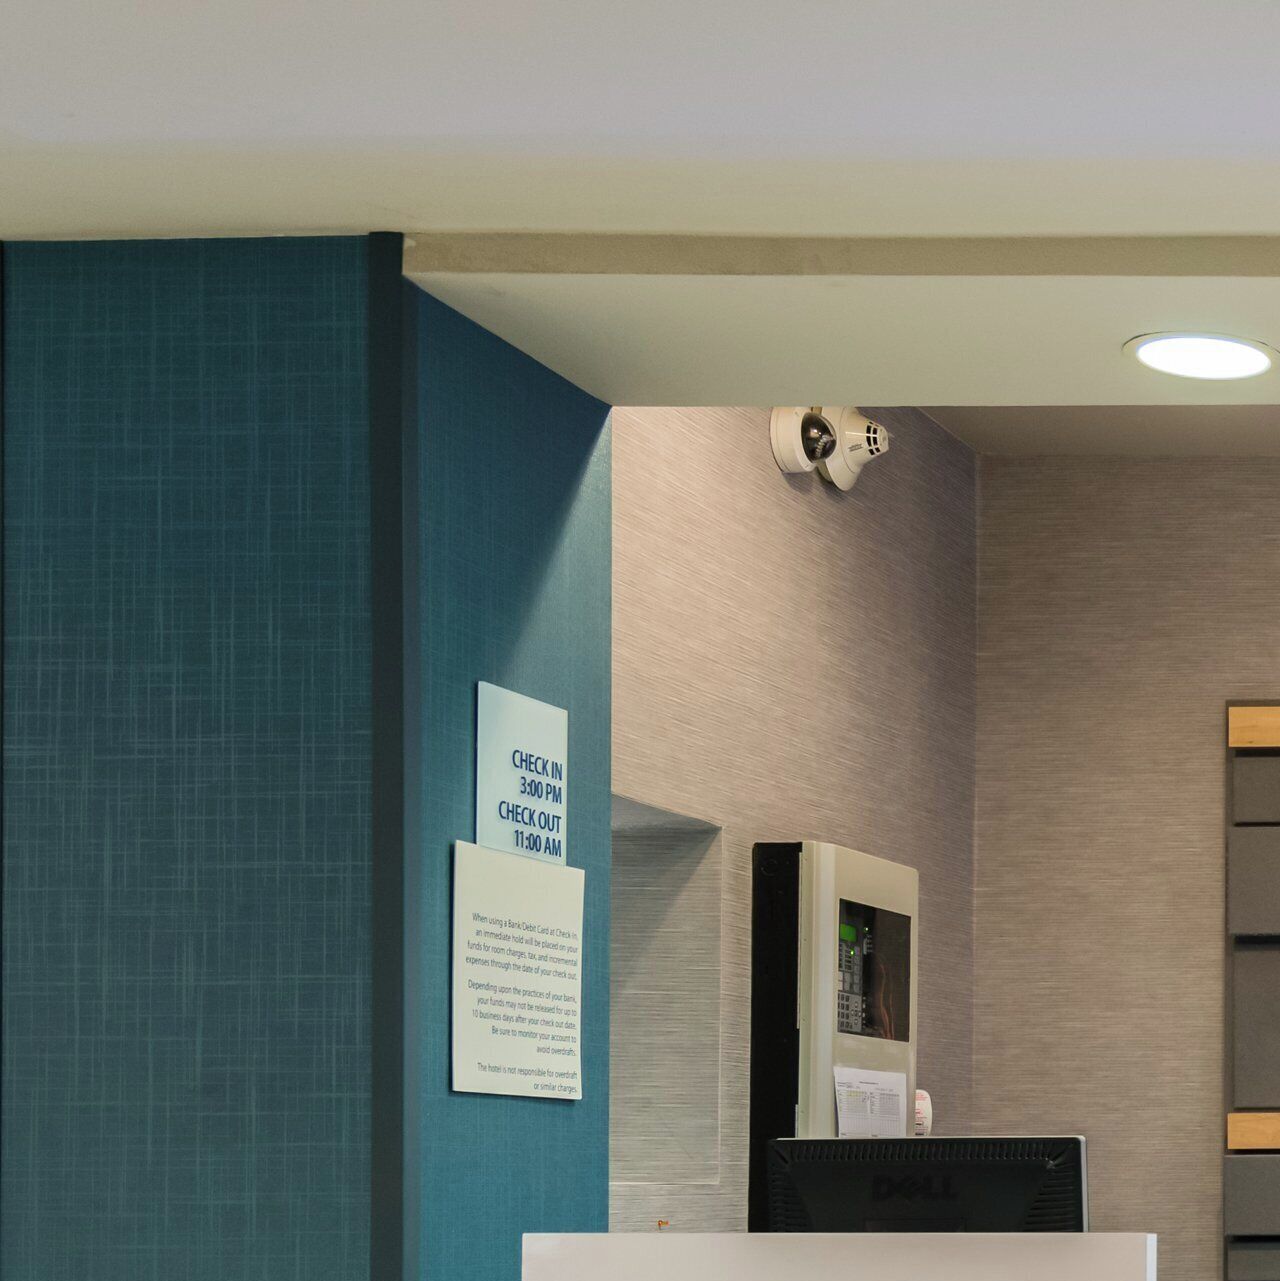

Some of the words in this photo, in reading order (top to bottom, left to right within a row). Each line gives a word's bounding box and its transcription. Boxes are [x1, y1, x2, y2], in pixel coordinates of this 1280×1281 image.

[512, 750, 549, 777] CHECK
[552, 761, 562, 781] IN
[520, 777, 543, 799] 3:00
[546, 783, 562, 804] PM
[499, 801, 536, 827] CHECK
[539, 812, 561, 833] OUT
[515, 830, 541, 852] 11:00
[544, 837, 561, 857] AM
[472, 913, 487, 923] When
[489, 917, 503, 928] using
[537, 925, 549, 935] Card
[484, 930, 511, 941] immediate
[512, 935, 523, 944] hold
[525, 936, 533, 946] will
[535, 938, 540, 947] be
[542, 939, 558, 950] placed
[559, 943, 566, 951] on
[567, 945, 578, 953] your
[468, 940, 482, 950] funds
[483, 942, 491, 952] for
[538, 952, 548, 962] and
[549, 956, 577, 966] incremental
[466, 956, 489, 967] expenses
[491, 958, 511, 972] through
[512, 963, 521, 971] the
[522, 964, 533, 973] date
[534, 965, 540, 974] of
[540, 968, 552, 976] your
[553, 969, 566, 978] check
[468, 979, 497, 994] Depending
[498, 985, 512, 994] upon
[512, 986, 521, 995] the
[522, 988, 544, 999] practices
[545, 989, 551, 999] of
[552, 993, 563, 1002] your
[477, 997, 489, 1006] your
[490, 997, 505, 1007] funds
[506, 1000, 516, 1010] may
[517, 1001, 526, 1010] not
[527, 1002, 534, 1011] be
[535, 1004, 555, 1013] released
[564, 1008, 571, 1016] up
[571, 1008, 577, 1016] to
[472, 1009, 478, 1018] 10
[479, 1010, 501, 1020] business
[502, 1013, 514, 1024] days
[515, 1014, 526, 1023] after
[540, 1016, 554, 1027] check
[555, 1020, 563, 1028] out
[492, 1025, 498, 1035] Be
[500, 1028, 510, 1036] sure
[511, 1029, 517, 1037] to
[518, 1029, 538, 1038] monitor
[538, 1032, 550, 1041] your
[550, 1034, 570, 1042] account
[571, 1035, 577, 1043] to
[537, 1045, 550, 1053] avoid
[477, 1062, 487, 1070] The
[488, 1063, 501, 1072] hotel
[503, 1065, 507, 1073] is
[507, 1066, 516, 1074] not
[517, 1067, 546, 1077] responsible
[555, 1069, 577, 1080] overdraft
[534, 1082, 539, 1090] or
[540, 1081, 556, 1091] similar
